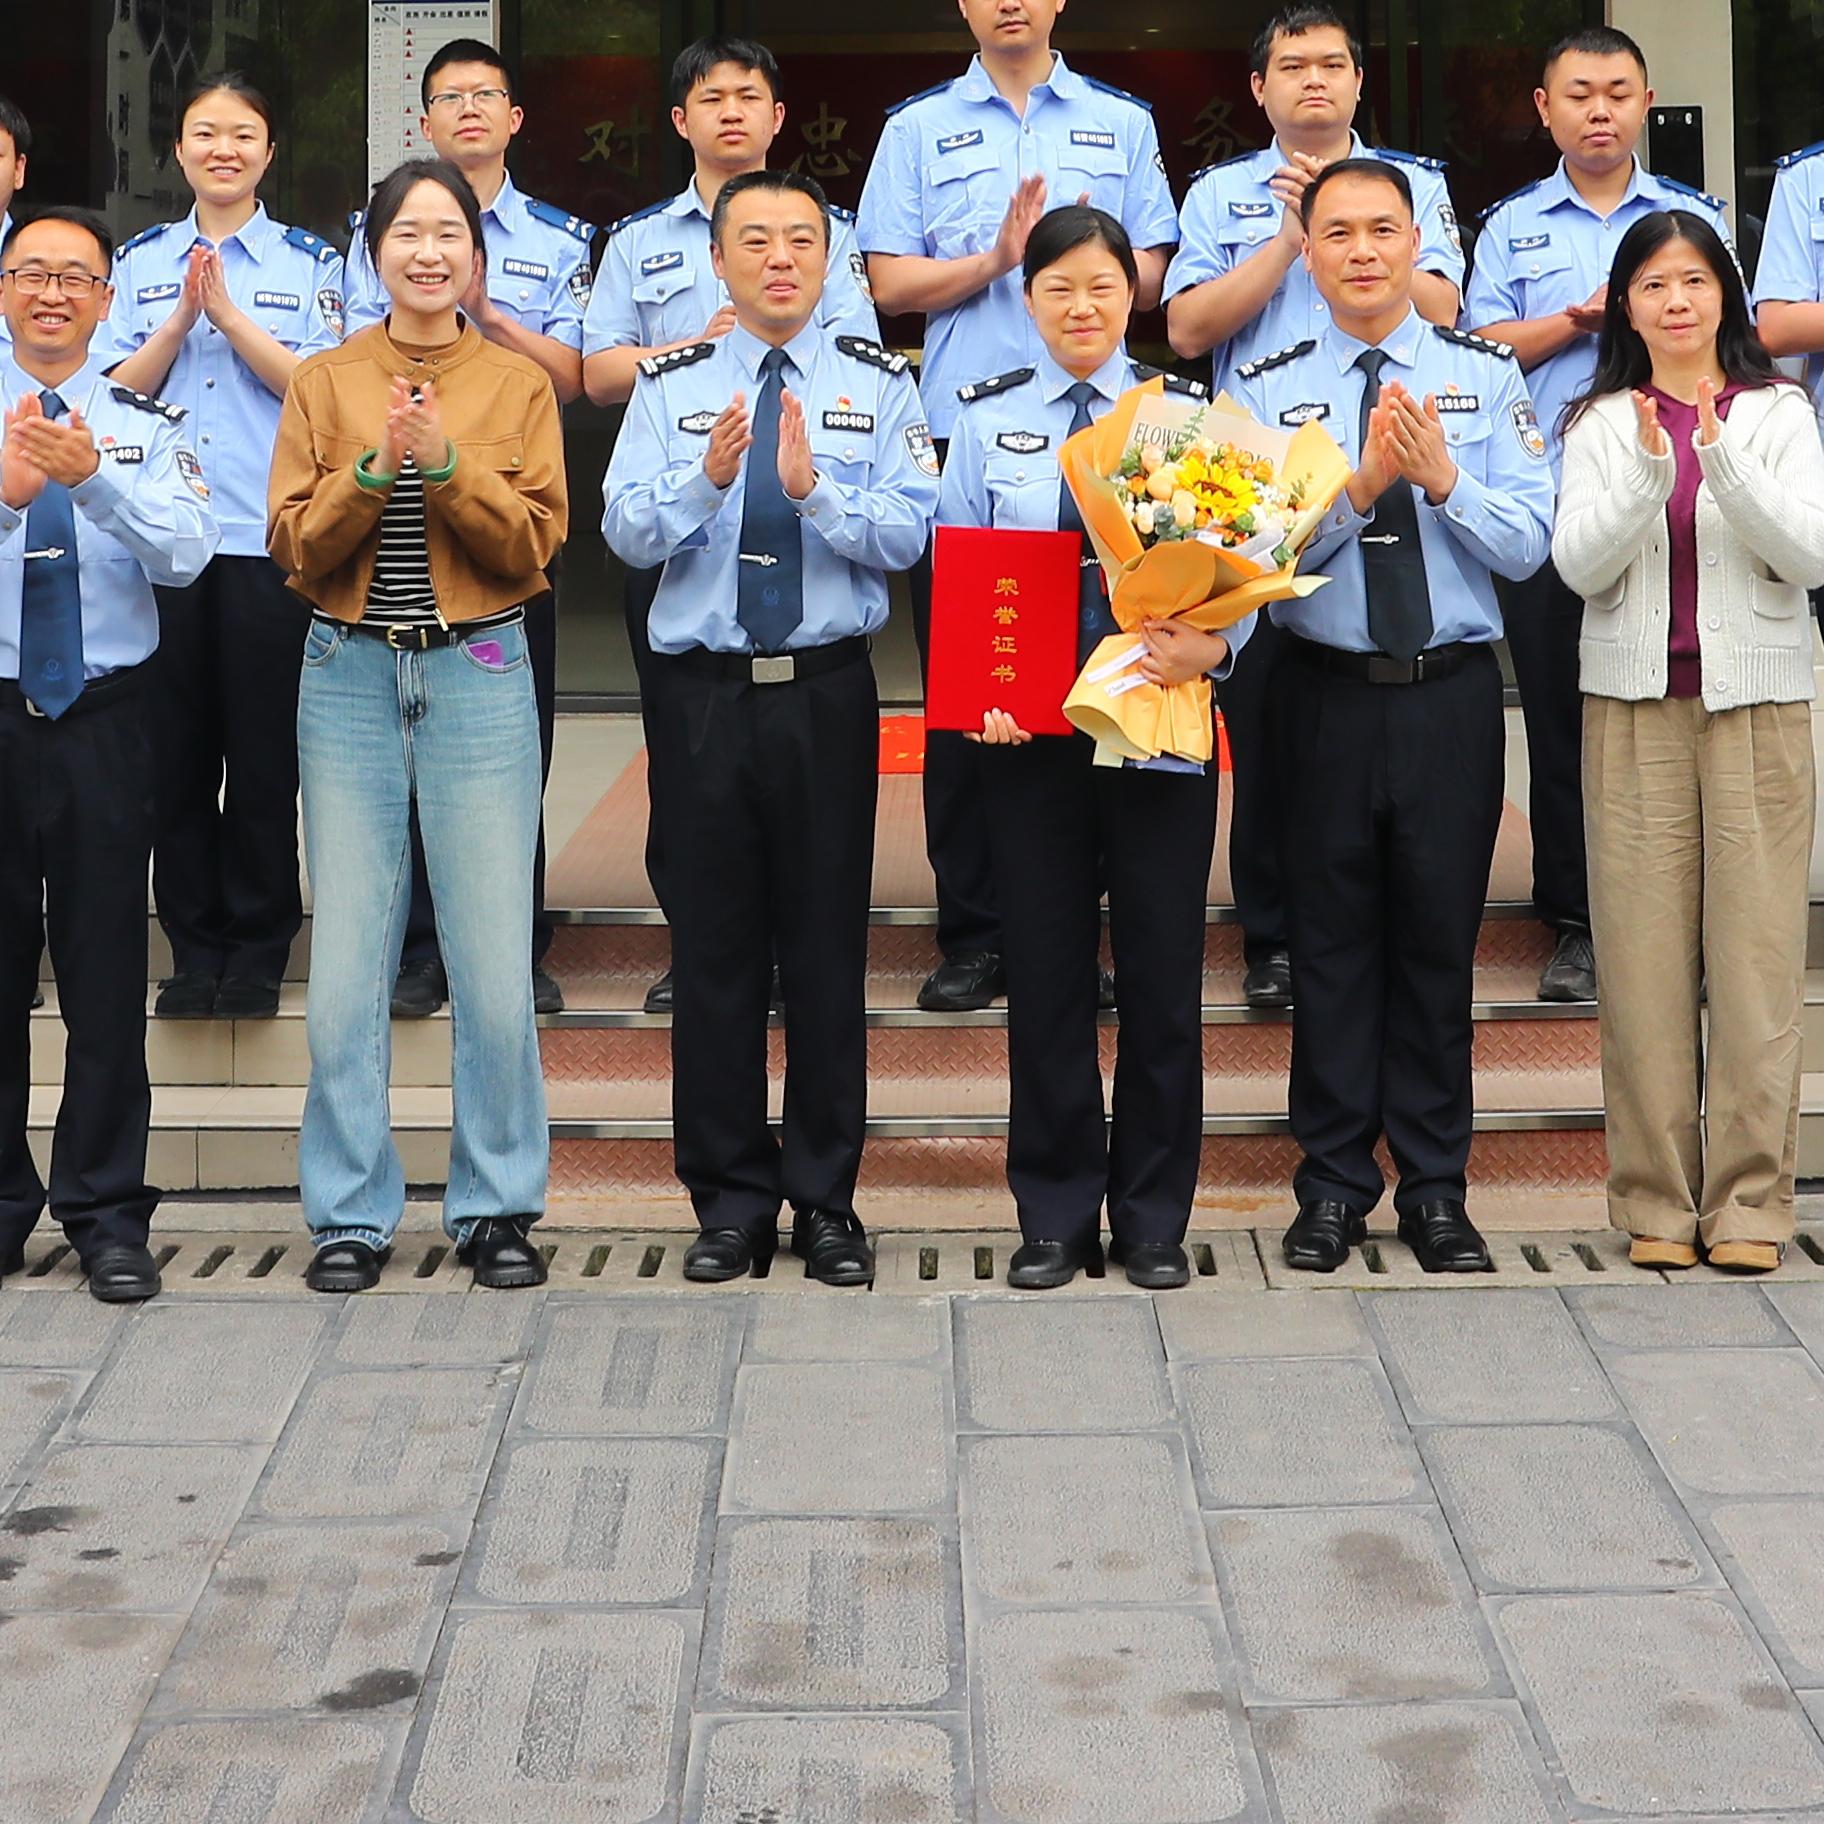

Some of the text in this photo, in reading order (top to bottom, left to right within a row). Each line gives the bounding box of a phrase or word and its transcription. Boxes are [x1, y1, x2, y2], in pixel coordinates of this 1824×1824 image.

[826, 413, 871, 428] 000400
[990, 577, 1020, 683] 荣誉证书
